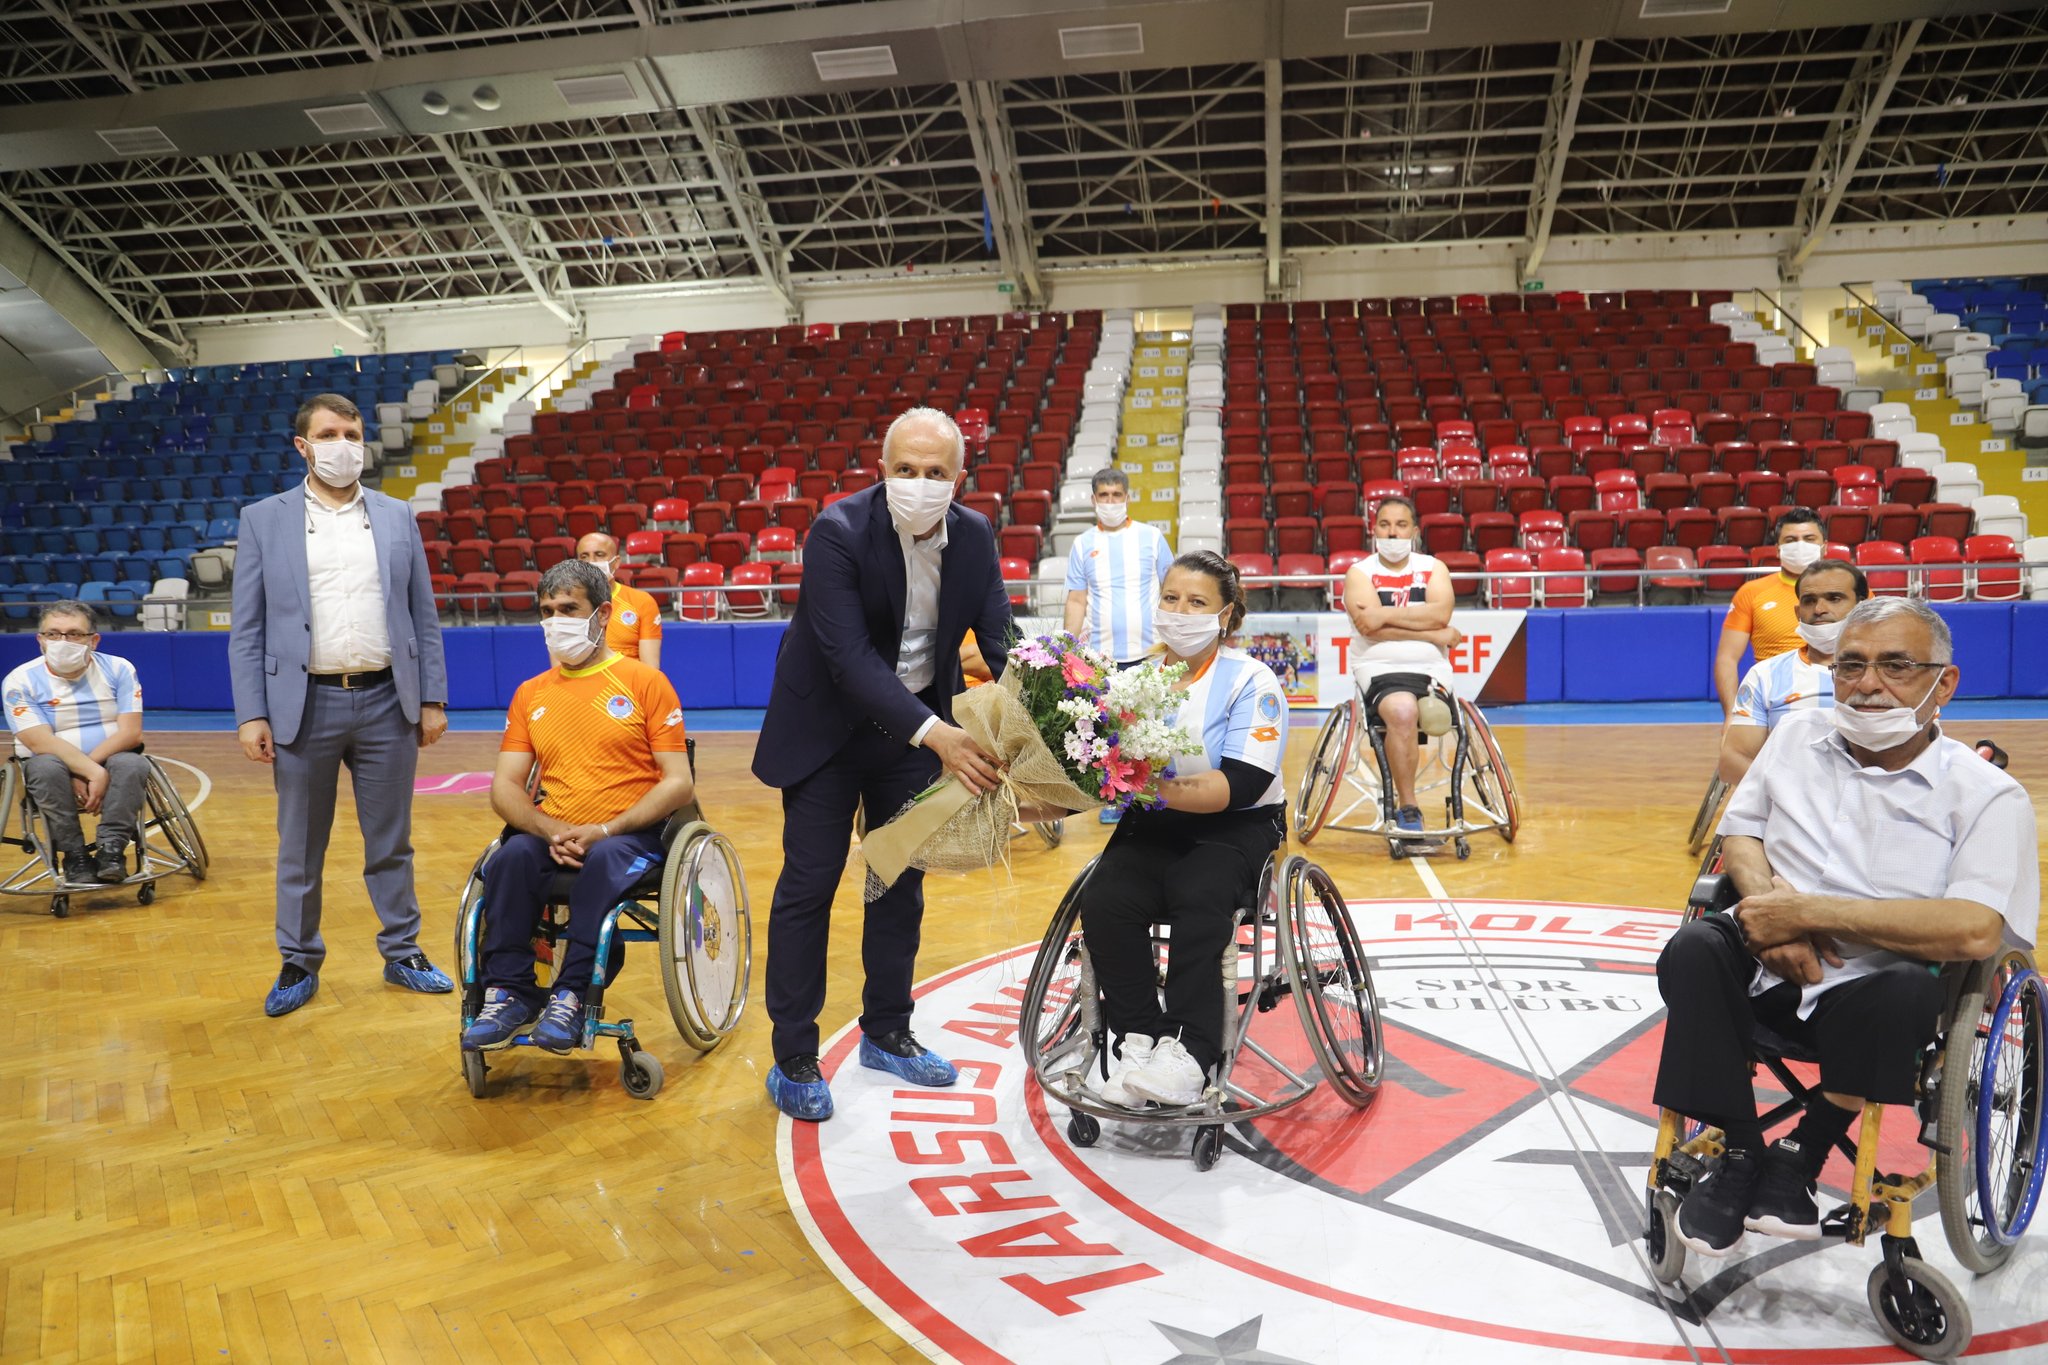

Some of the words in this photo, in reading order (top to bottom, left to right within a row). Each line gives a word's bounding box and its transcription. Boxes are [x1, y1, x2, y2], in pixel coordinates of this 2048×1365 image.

[1415, 978, 1580, 992] SPOR
[1374, 994, 1643, 1012] KULÜBÜ
[889, 1058, 1164, 1316] TARSUS
[1393, 913, 1681, 942] KOLE
